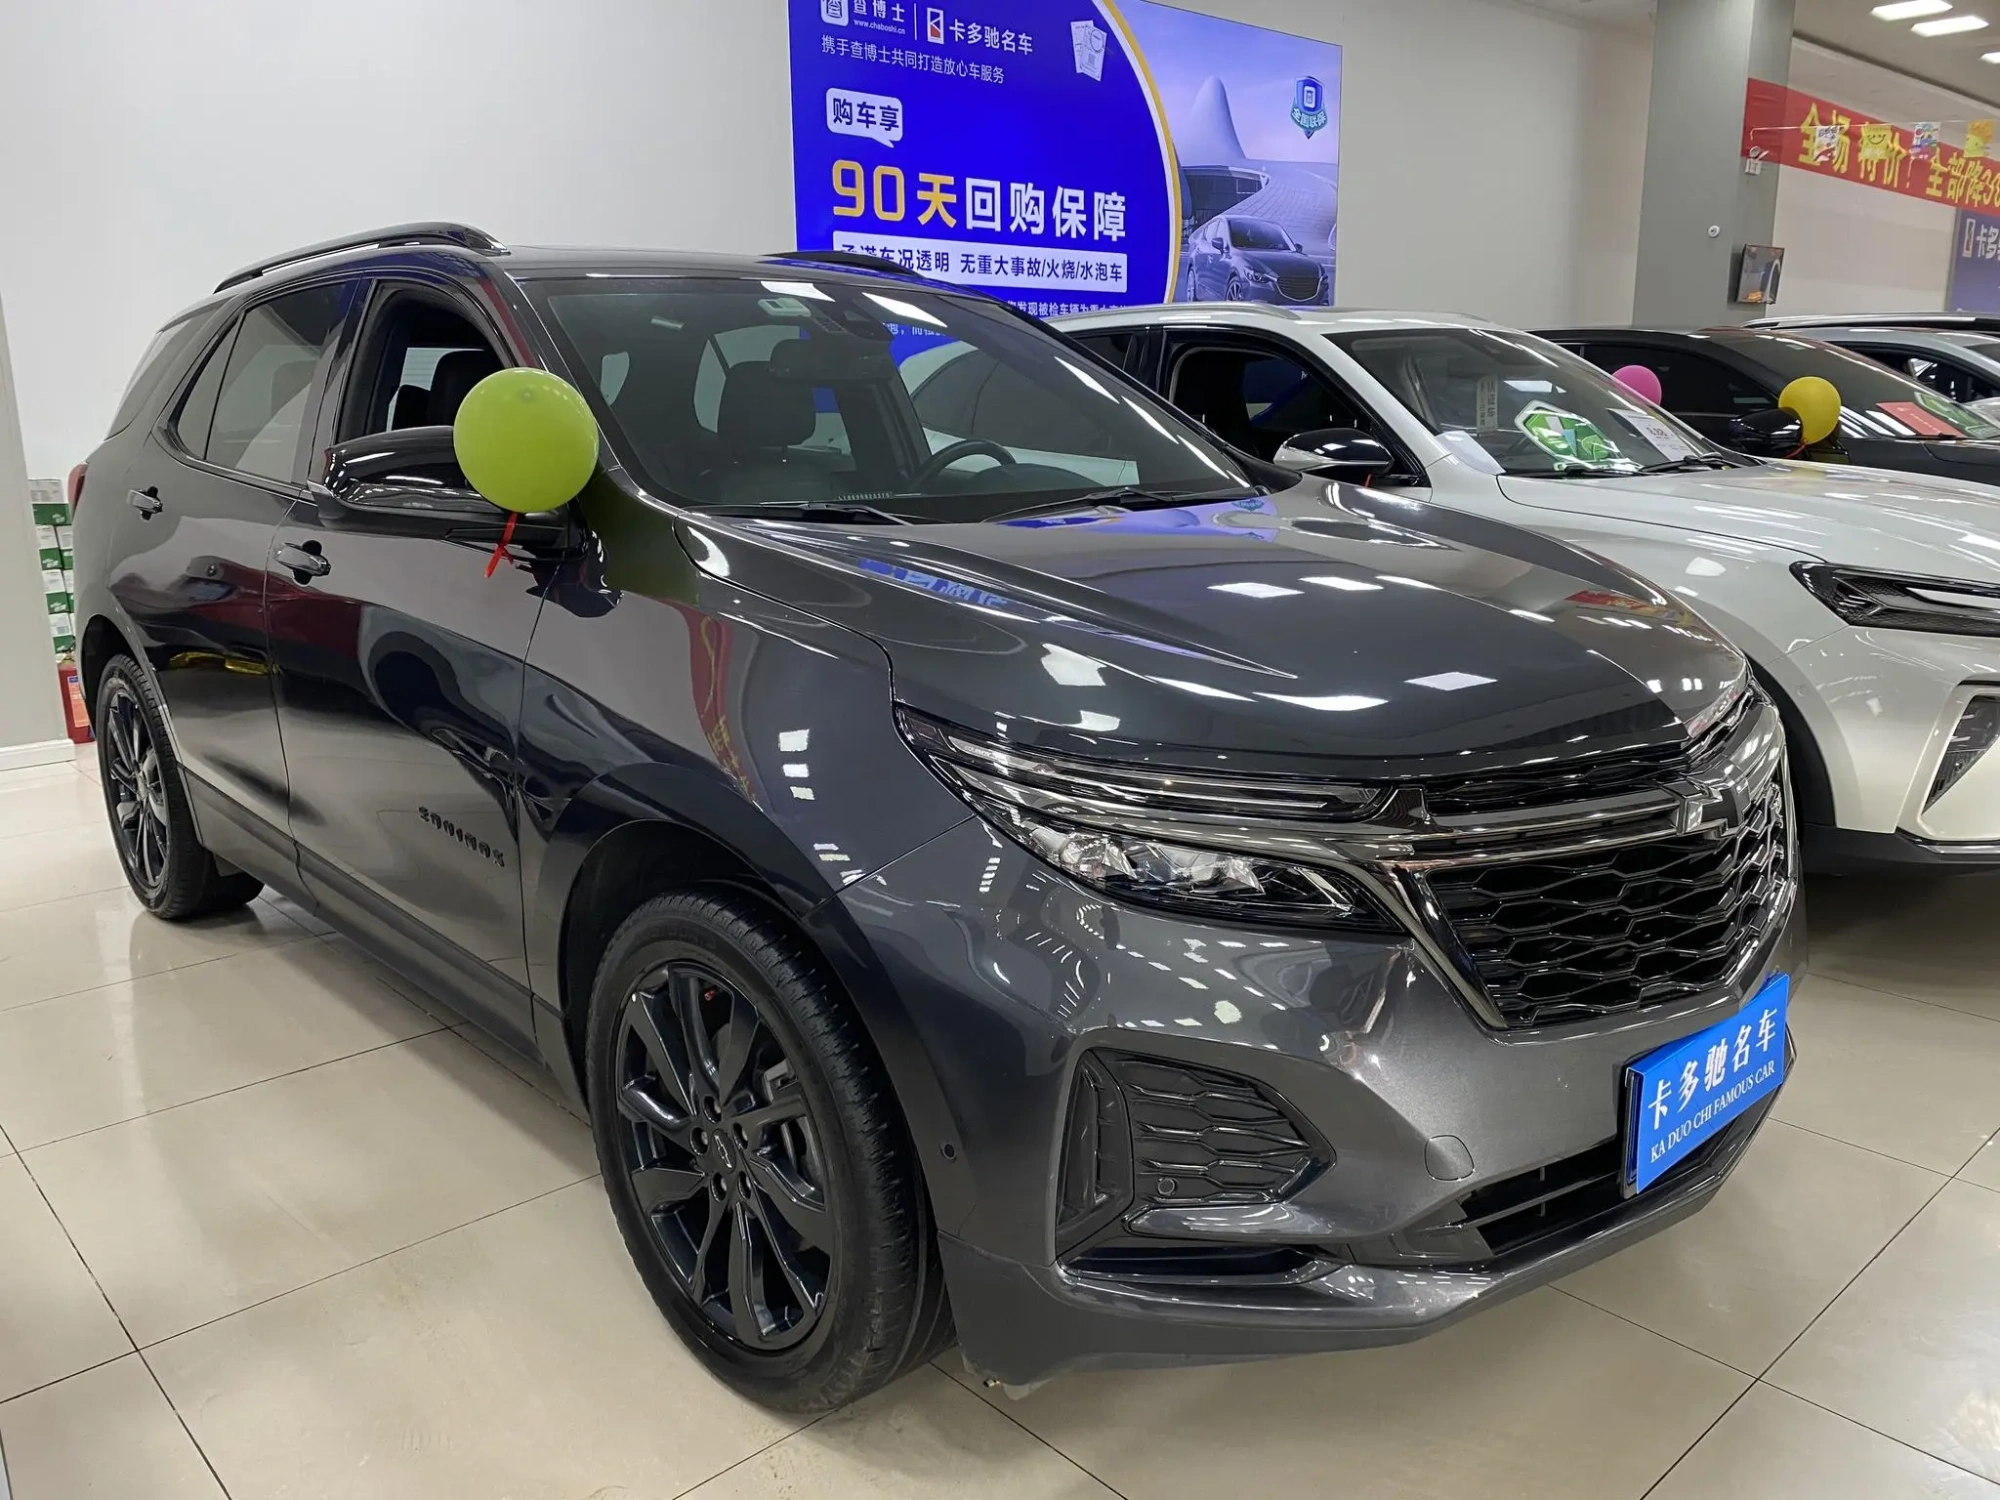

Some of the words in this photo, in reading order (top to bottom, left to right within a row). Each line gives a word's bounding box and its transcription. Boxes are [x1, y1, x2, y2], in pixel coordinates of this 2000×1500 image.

[853, 0, 905, 22] 查博士
[853, 20, 906, 35] www.chaboshi.cn
[949, 19, 1033, 55] 卡多驰名车
[821, 34, 1005, 84] 携手查博士共同打造放心车服务
[832, 97, 900, 131] 购车享
[832, 159, 1126, 242] 90天回购保障
[960, 253, 1123, 283] 无重大事故/火烧/水泡车
[1648, 1008, 1778, 1130] 卡多驰名车
[1650, 1143, 1665, 1164] KA
[1667, 1120, 1692, 1149] DUO
[1693, 1106, 1712, 1129] CHI
[1713, 1075, 1754, 1114] FAMOUS
[1755, 1060, 1775, 1084] CAR
